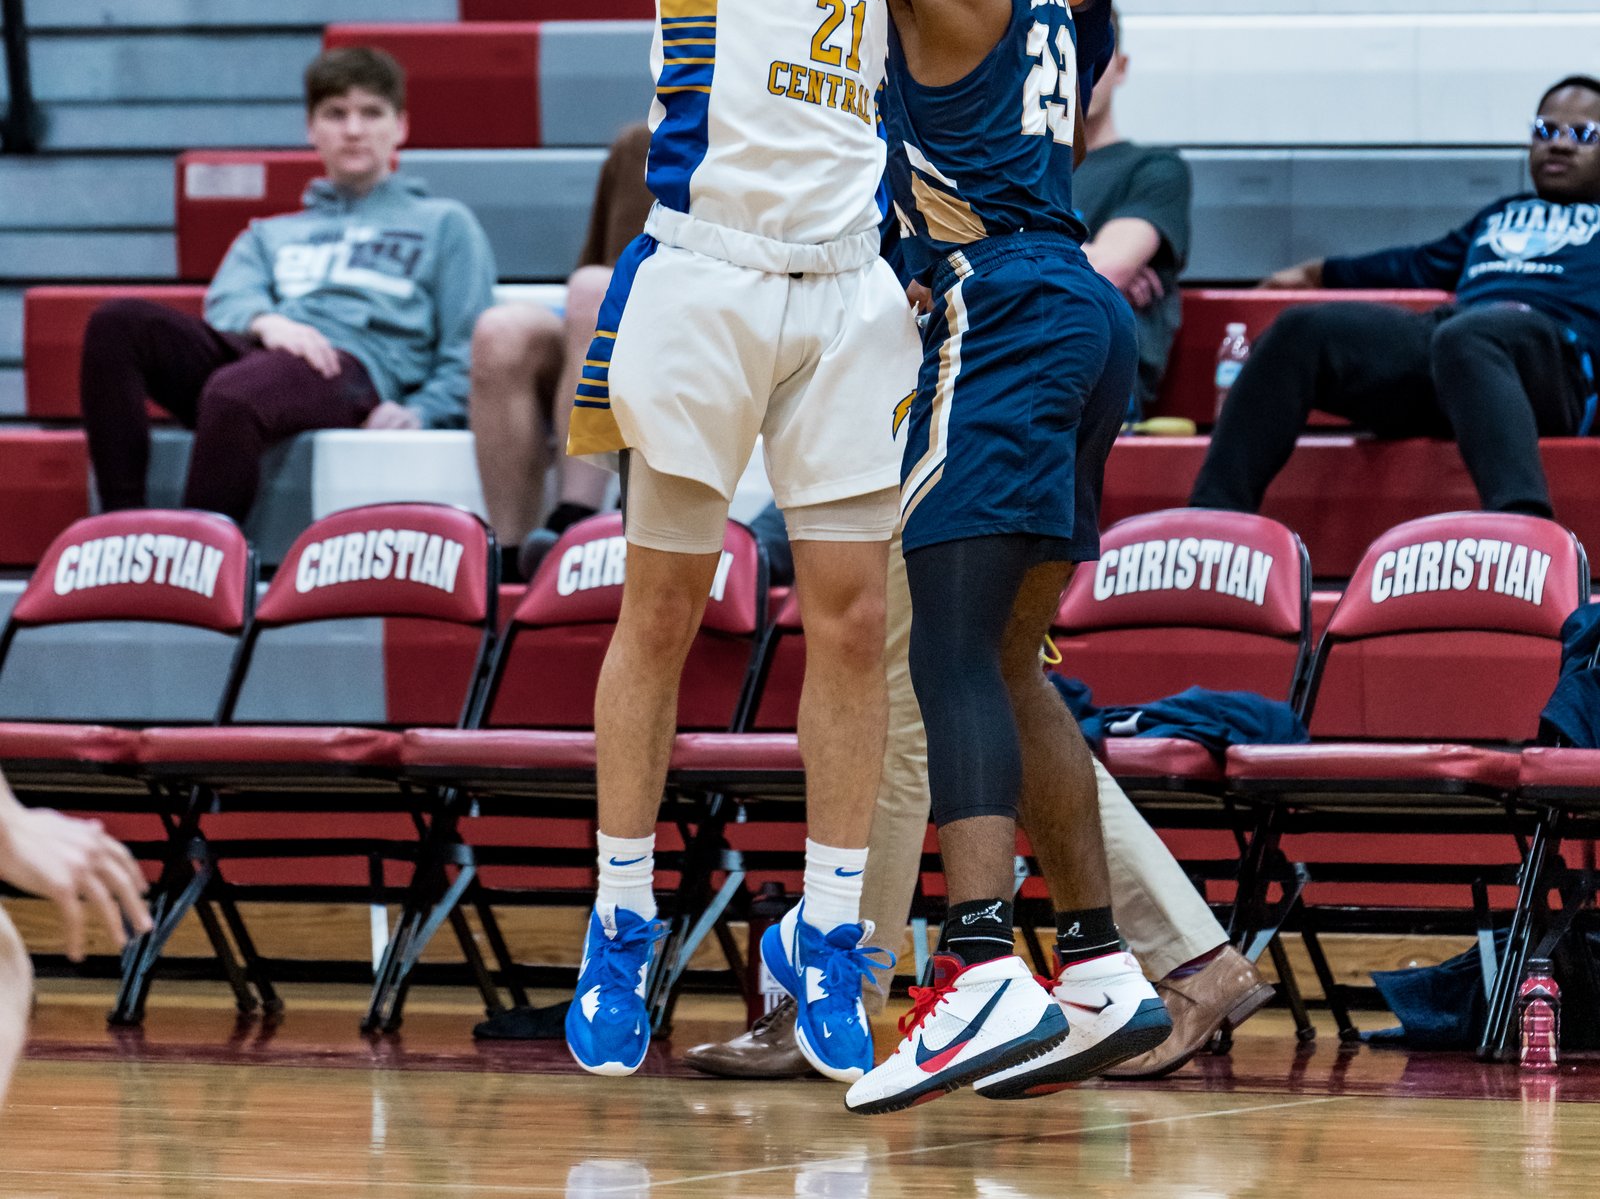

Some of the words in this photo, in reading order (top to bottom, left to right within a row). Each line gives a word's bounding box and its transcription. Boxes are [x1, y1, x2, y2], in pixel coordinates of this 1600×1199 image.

[767, 60, 871, 125] CENTRAL
[54, 533, 224, 598] CHRISTIAN
[294, 528, 464, 593] CHRISTIAN
[1093, 537, 1273, 606] CHRISTIAN
[1370, 538, 1551, 605] CHRISTIAN
